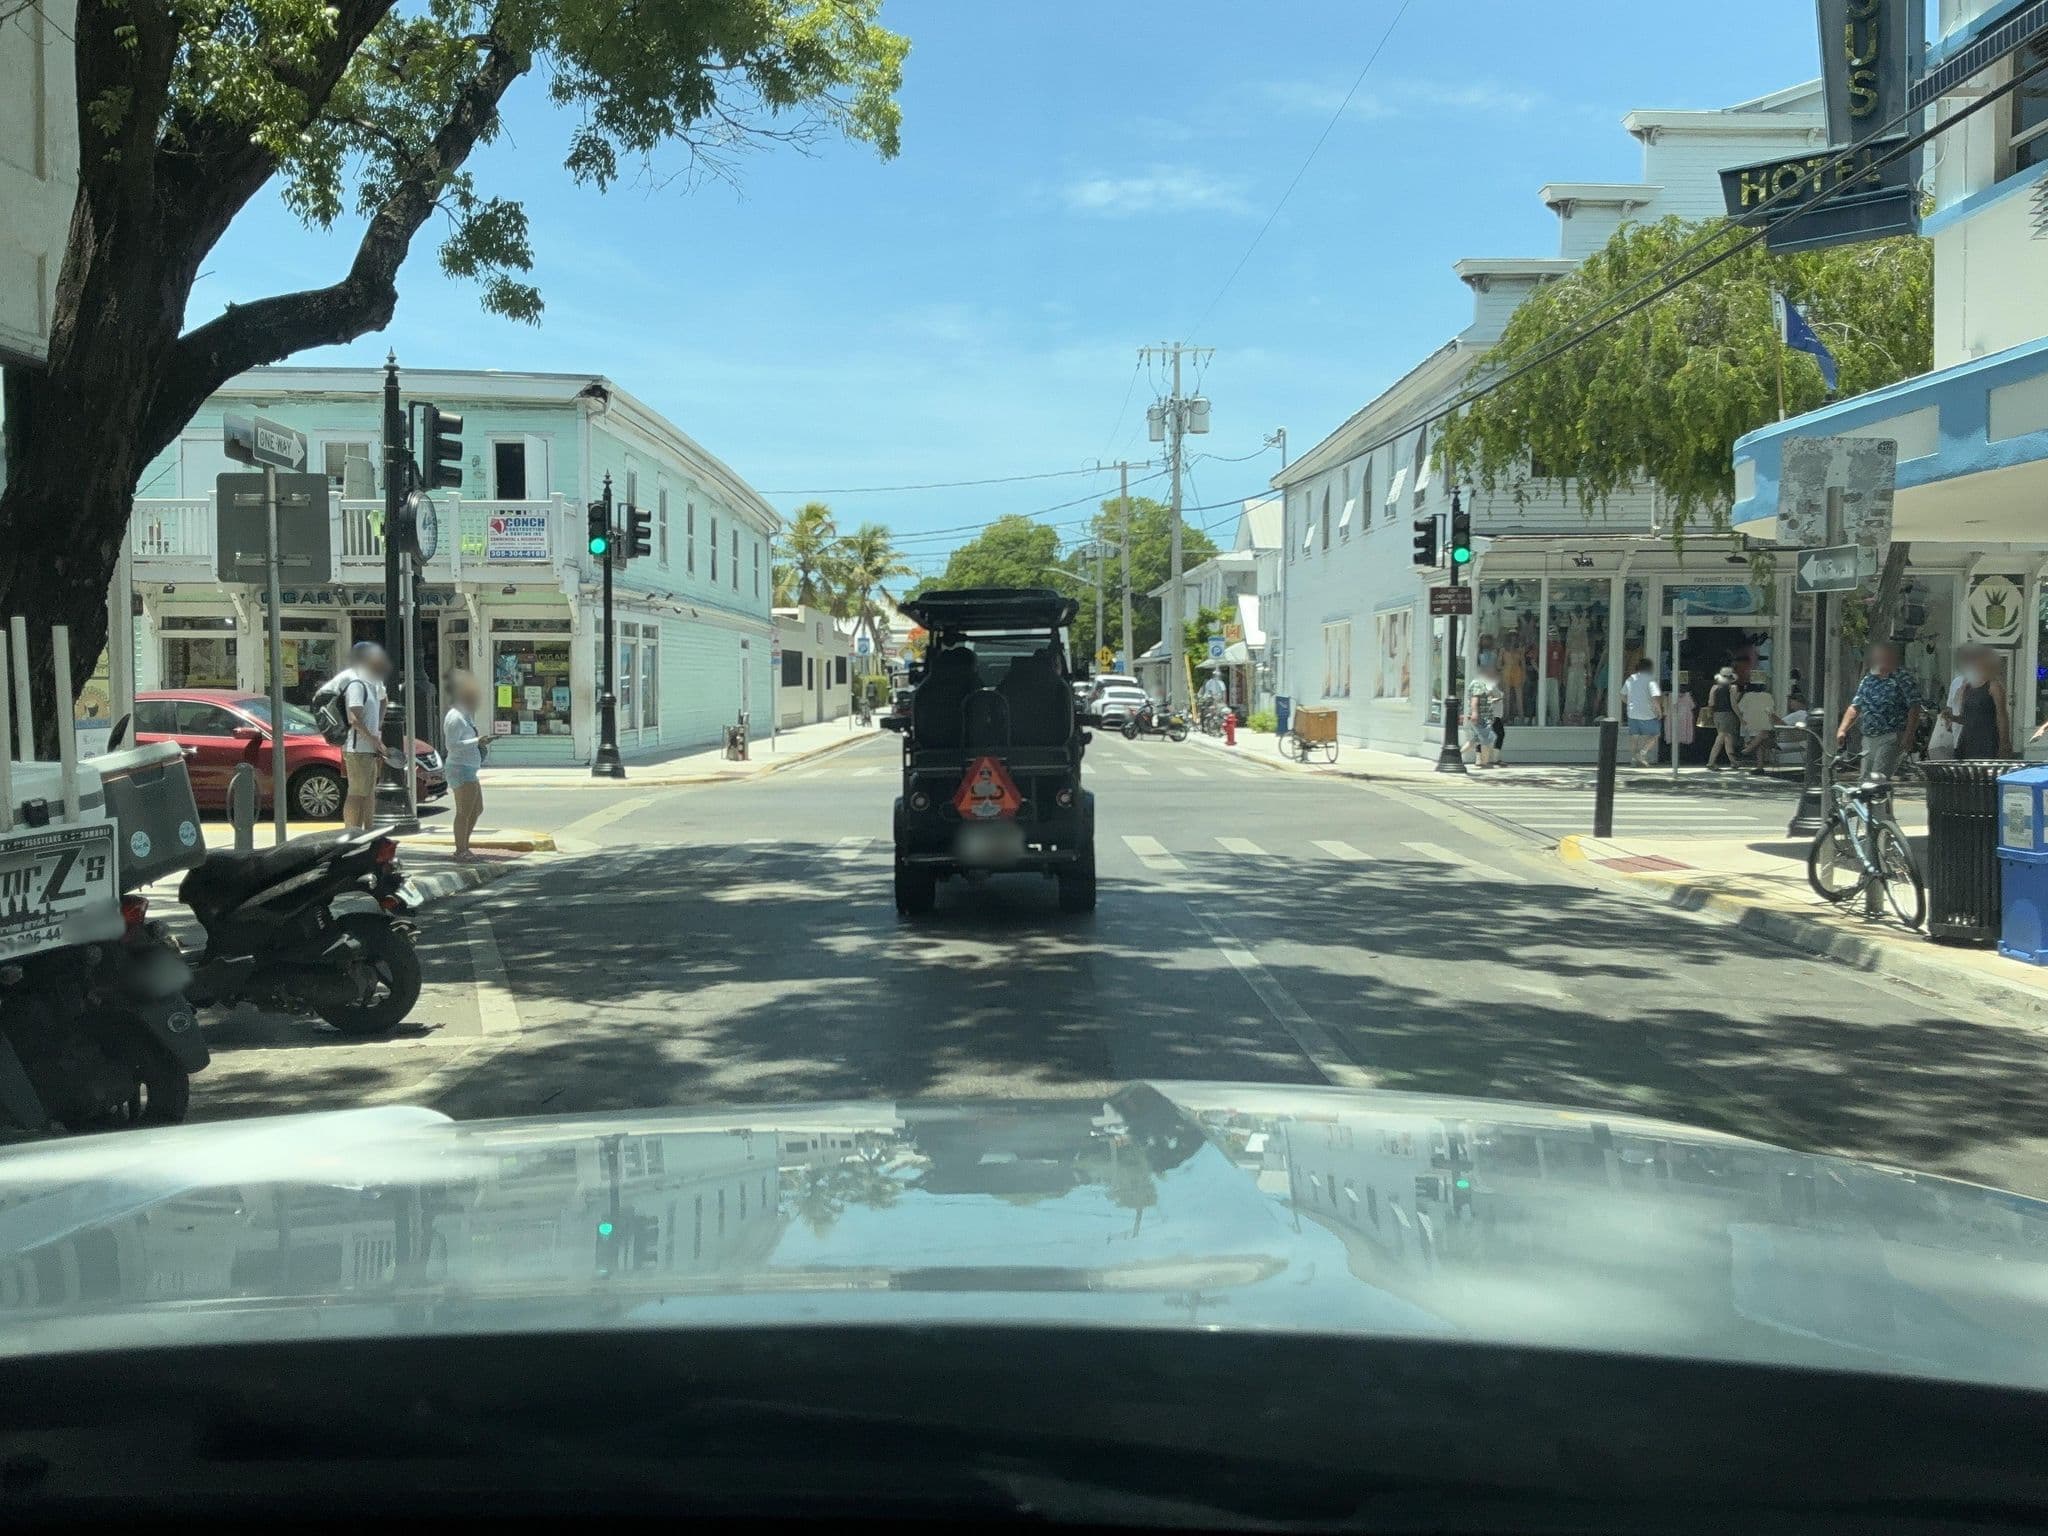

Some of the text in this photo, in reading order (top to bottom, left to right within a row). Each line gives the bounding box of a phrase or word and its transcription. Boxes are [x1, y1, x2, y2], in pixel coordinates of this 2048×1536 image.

[1740, 149, 1882, 206] HOTEL
[259, 431, 292, 457] ONE WAY
[506, 518, 545, 527] CONCH
[260, 591, 457, 606] CGAR FAORY
